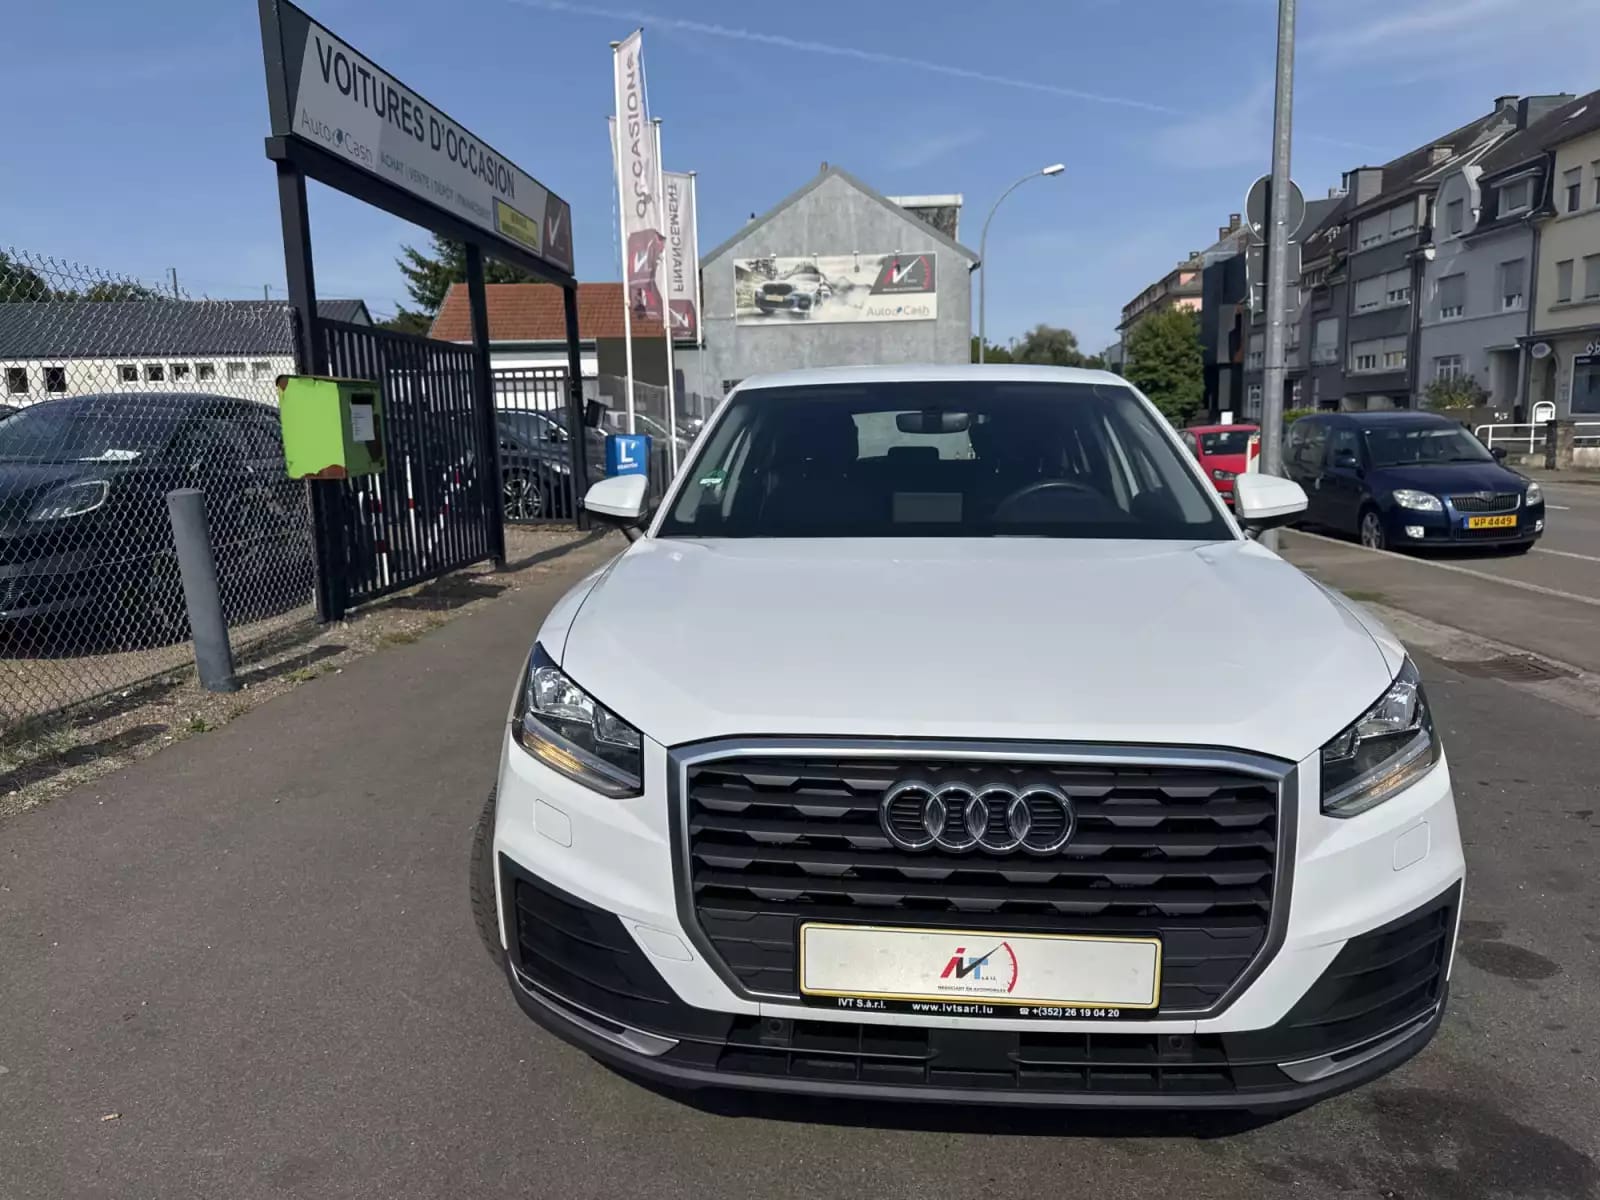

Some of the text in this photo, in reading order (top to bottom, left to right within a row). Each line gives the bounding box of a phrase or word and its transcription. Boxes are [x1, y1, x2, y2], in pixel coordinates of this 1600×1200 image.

[315, 36, 515, 200] VOITURES D'OCCASION
[345, 132, 373, 164] Cash
[838, 998, 853, 1006] IVT
[912, 1002, 993, 1014] www.ivtsarl.lu
[1032, 1007, 1062, 1017] +(352)
[1065, 1008, 1077, 1017] 26
[1080, 1008, 1091, 1017] 19
[1093, 1008, 1105, 1018] 04
[1108, 1009, 1120, 1018] 20
